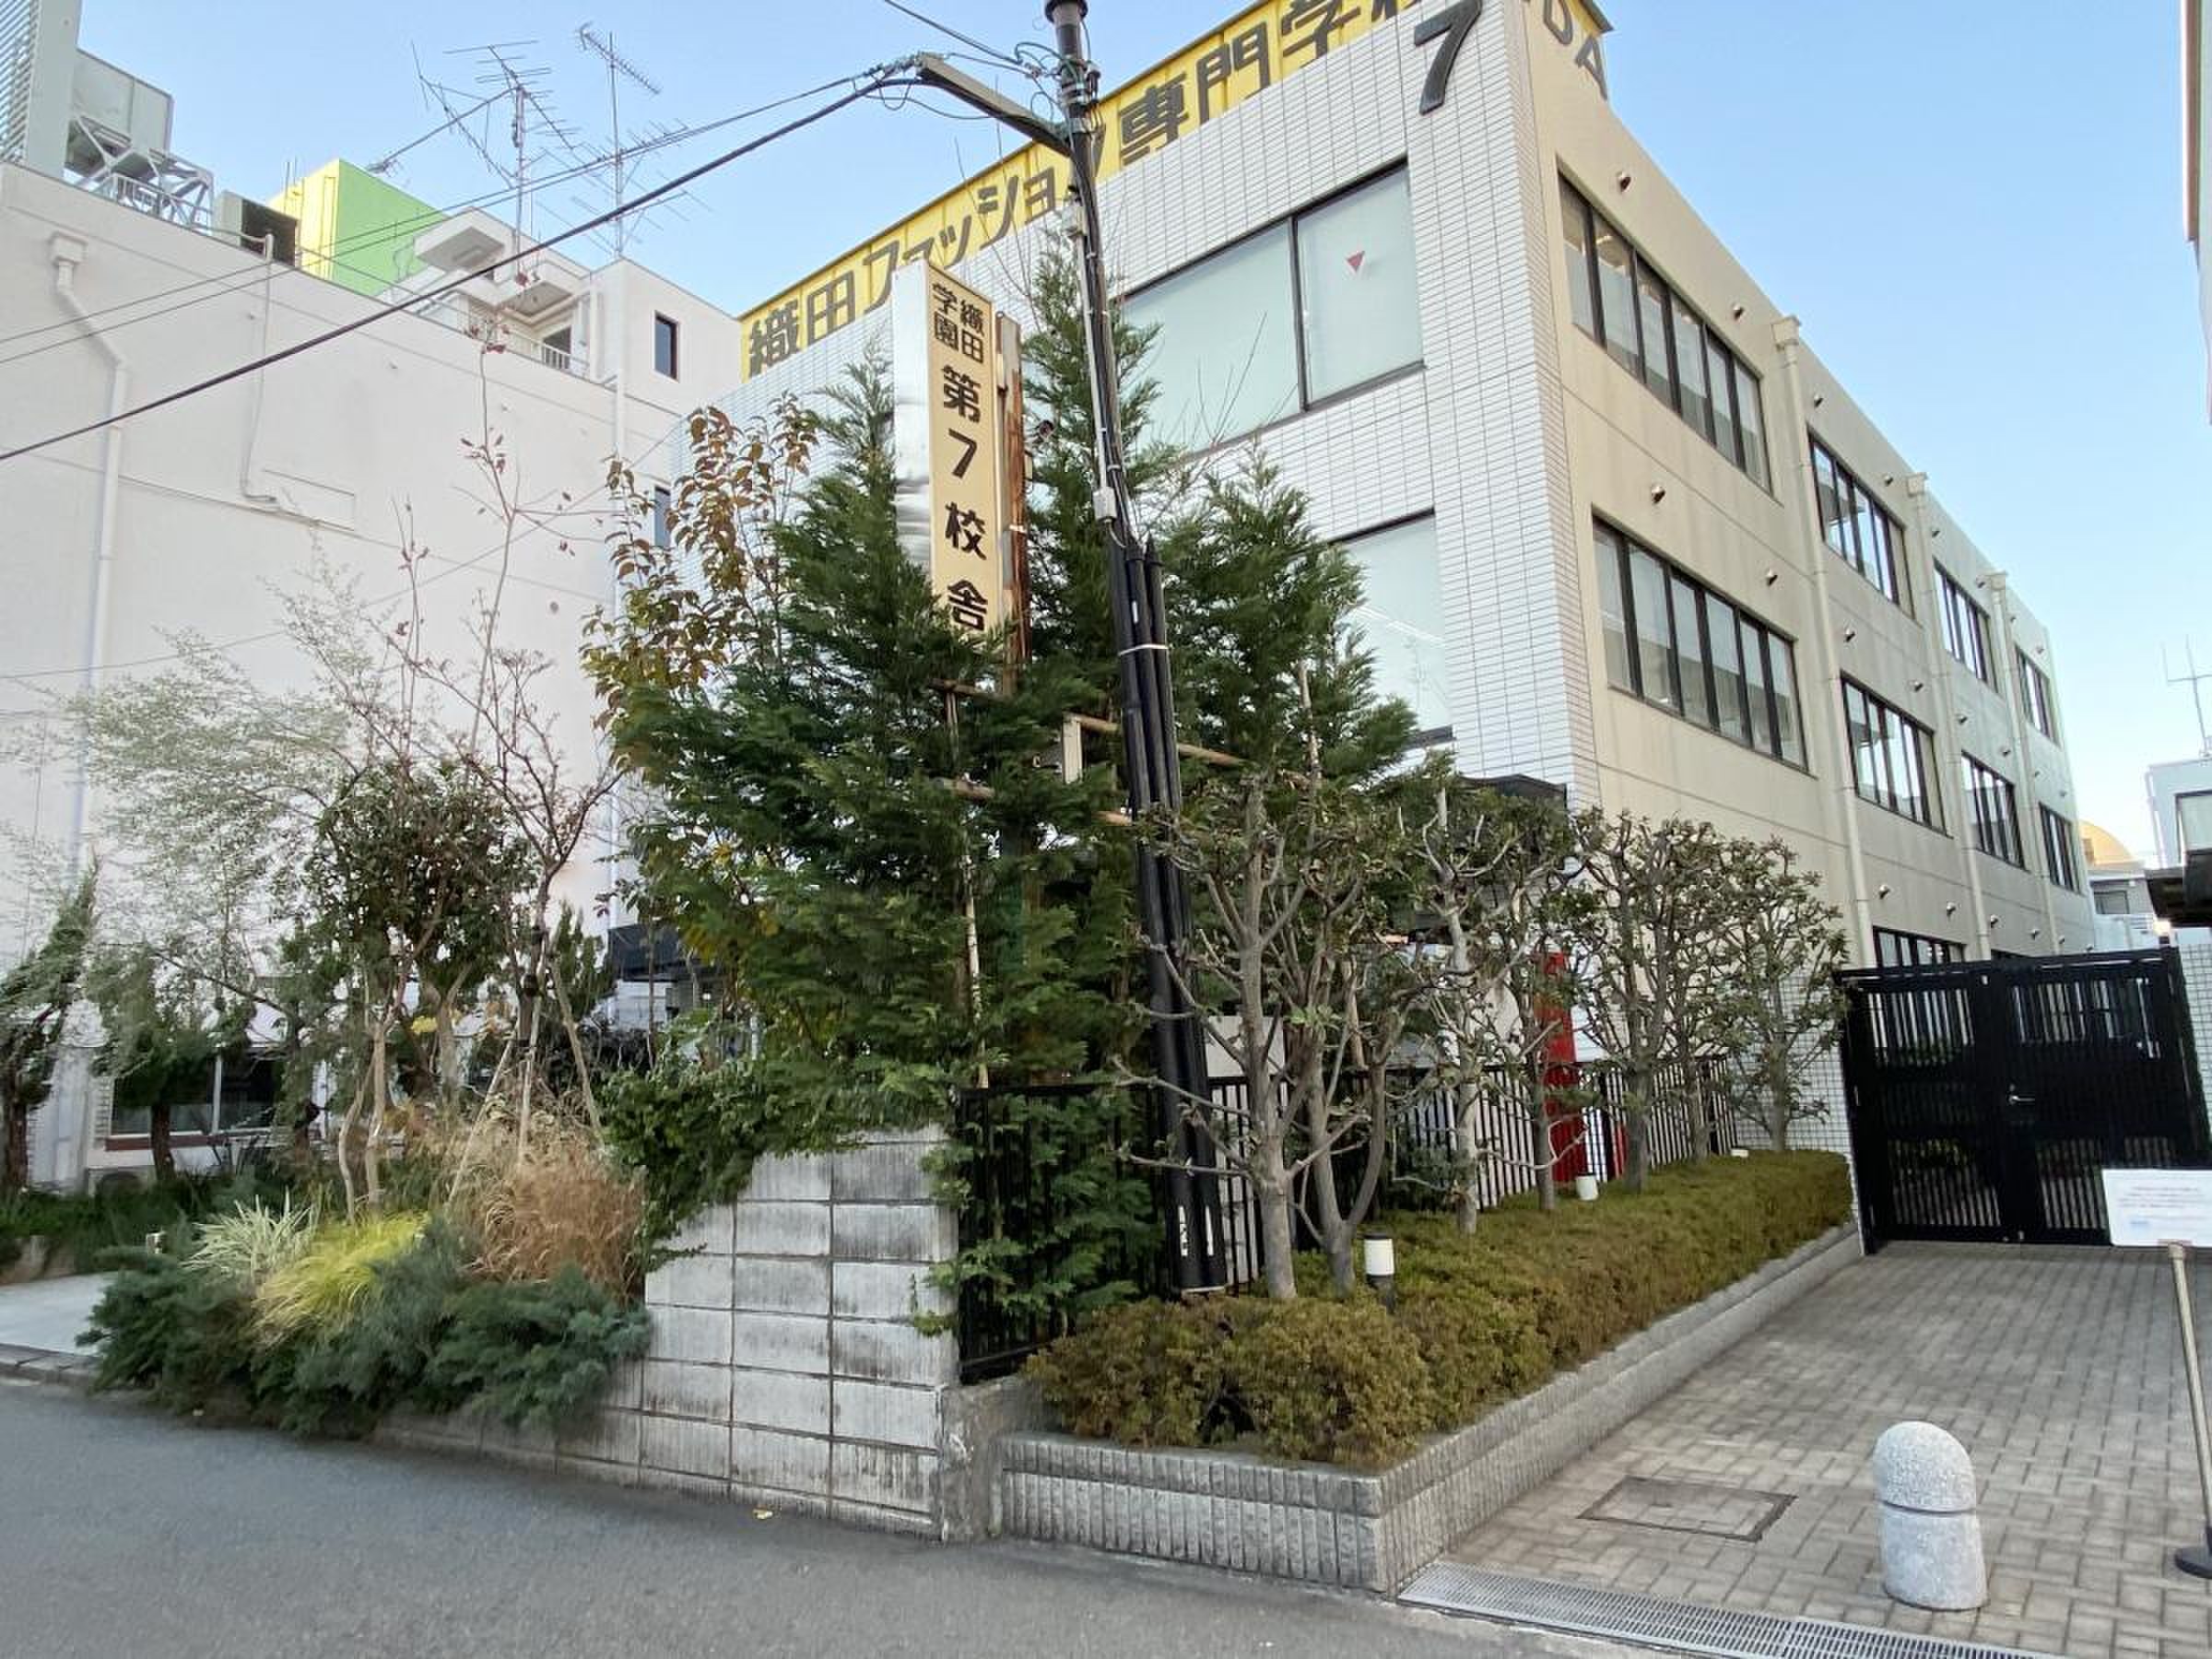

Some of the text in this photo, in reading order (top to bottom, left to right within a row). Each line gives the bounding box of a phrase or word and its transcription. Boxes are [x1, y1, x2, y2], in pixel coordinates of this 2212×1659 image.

[748, 0, 1421, 378] 織田ファッショ専門学
[1414, 0, 1482, 115] 7
[942, 364, 988, 631] 第7校舎
